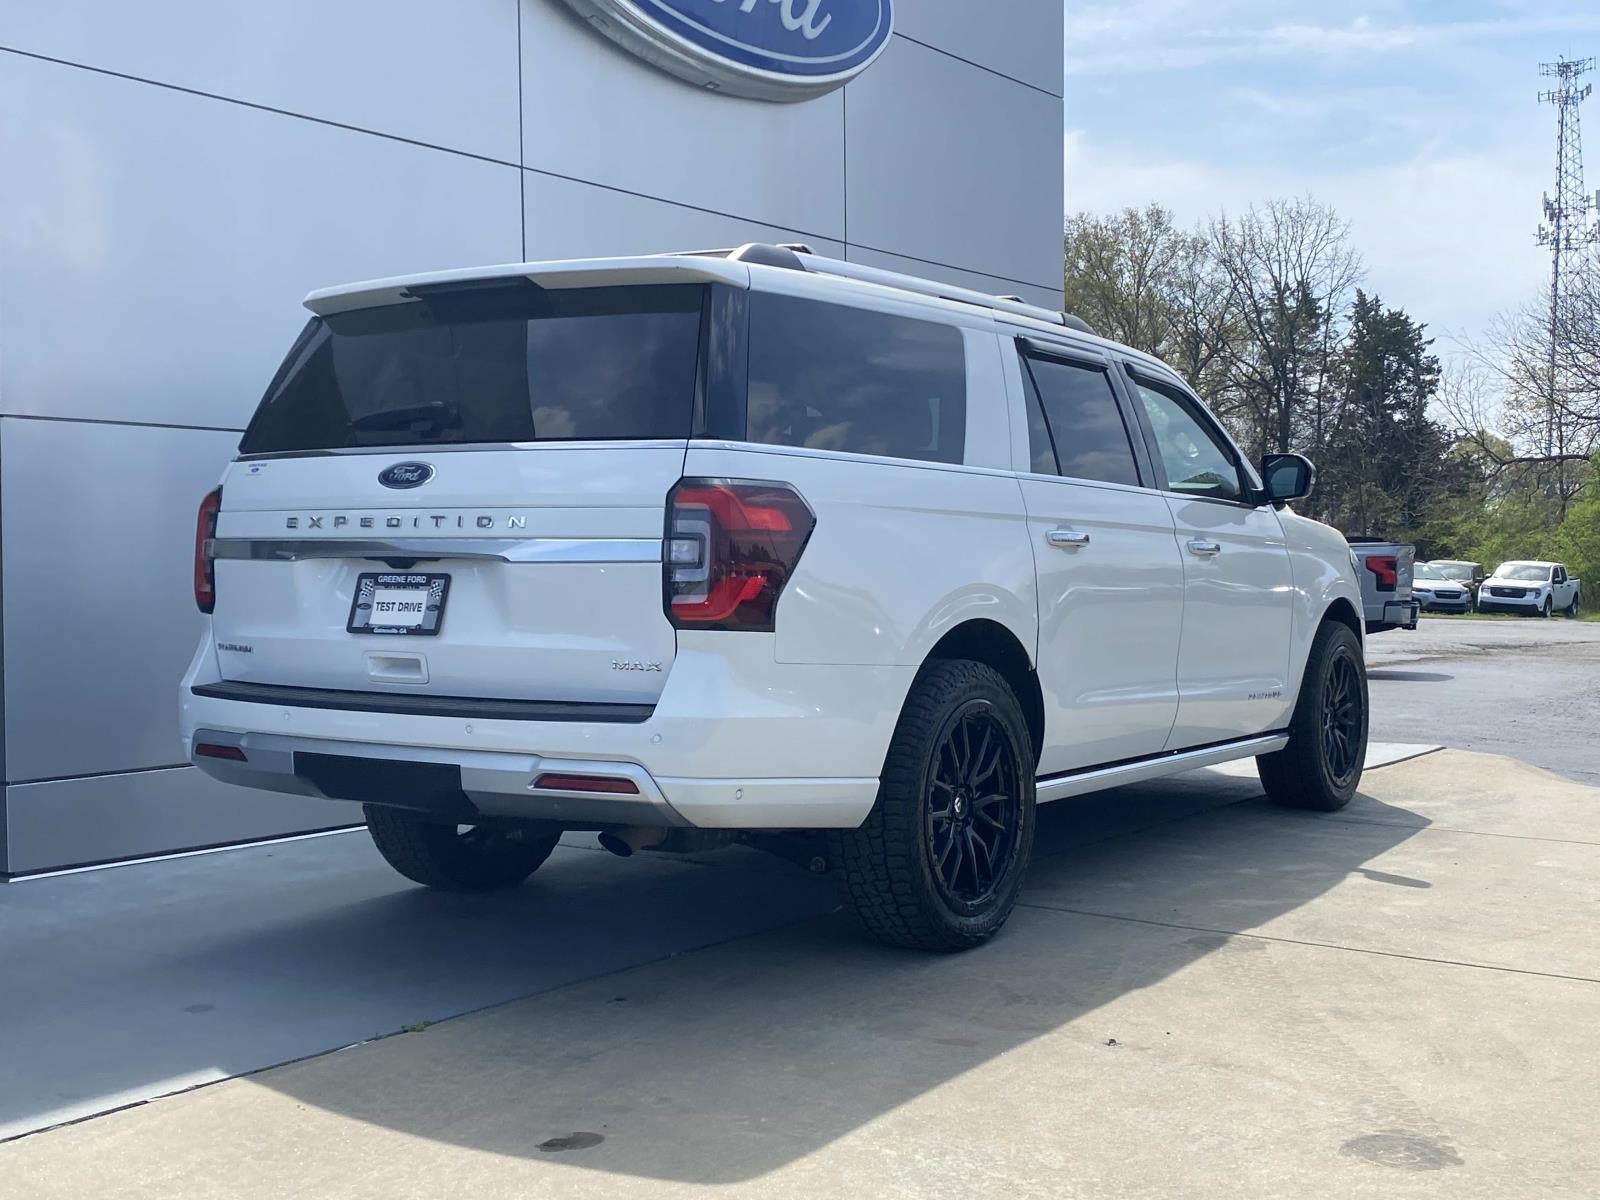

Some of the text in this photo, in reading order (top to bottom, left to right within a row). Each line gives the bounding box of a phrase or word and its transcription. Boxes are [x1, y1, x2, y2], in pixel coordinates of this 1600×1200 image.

[286, 514, 528, 530] EXPEDITION
[377, 575, 427, 584] GREENE FORD
[375, 601, 396, 612] TEST
[397, 602, 423, 612] DRIVE
[612, 660, 662, 672] MAX
